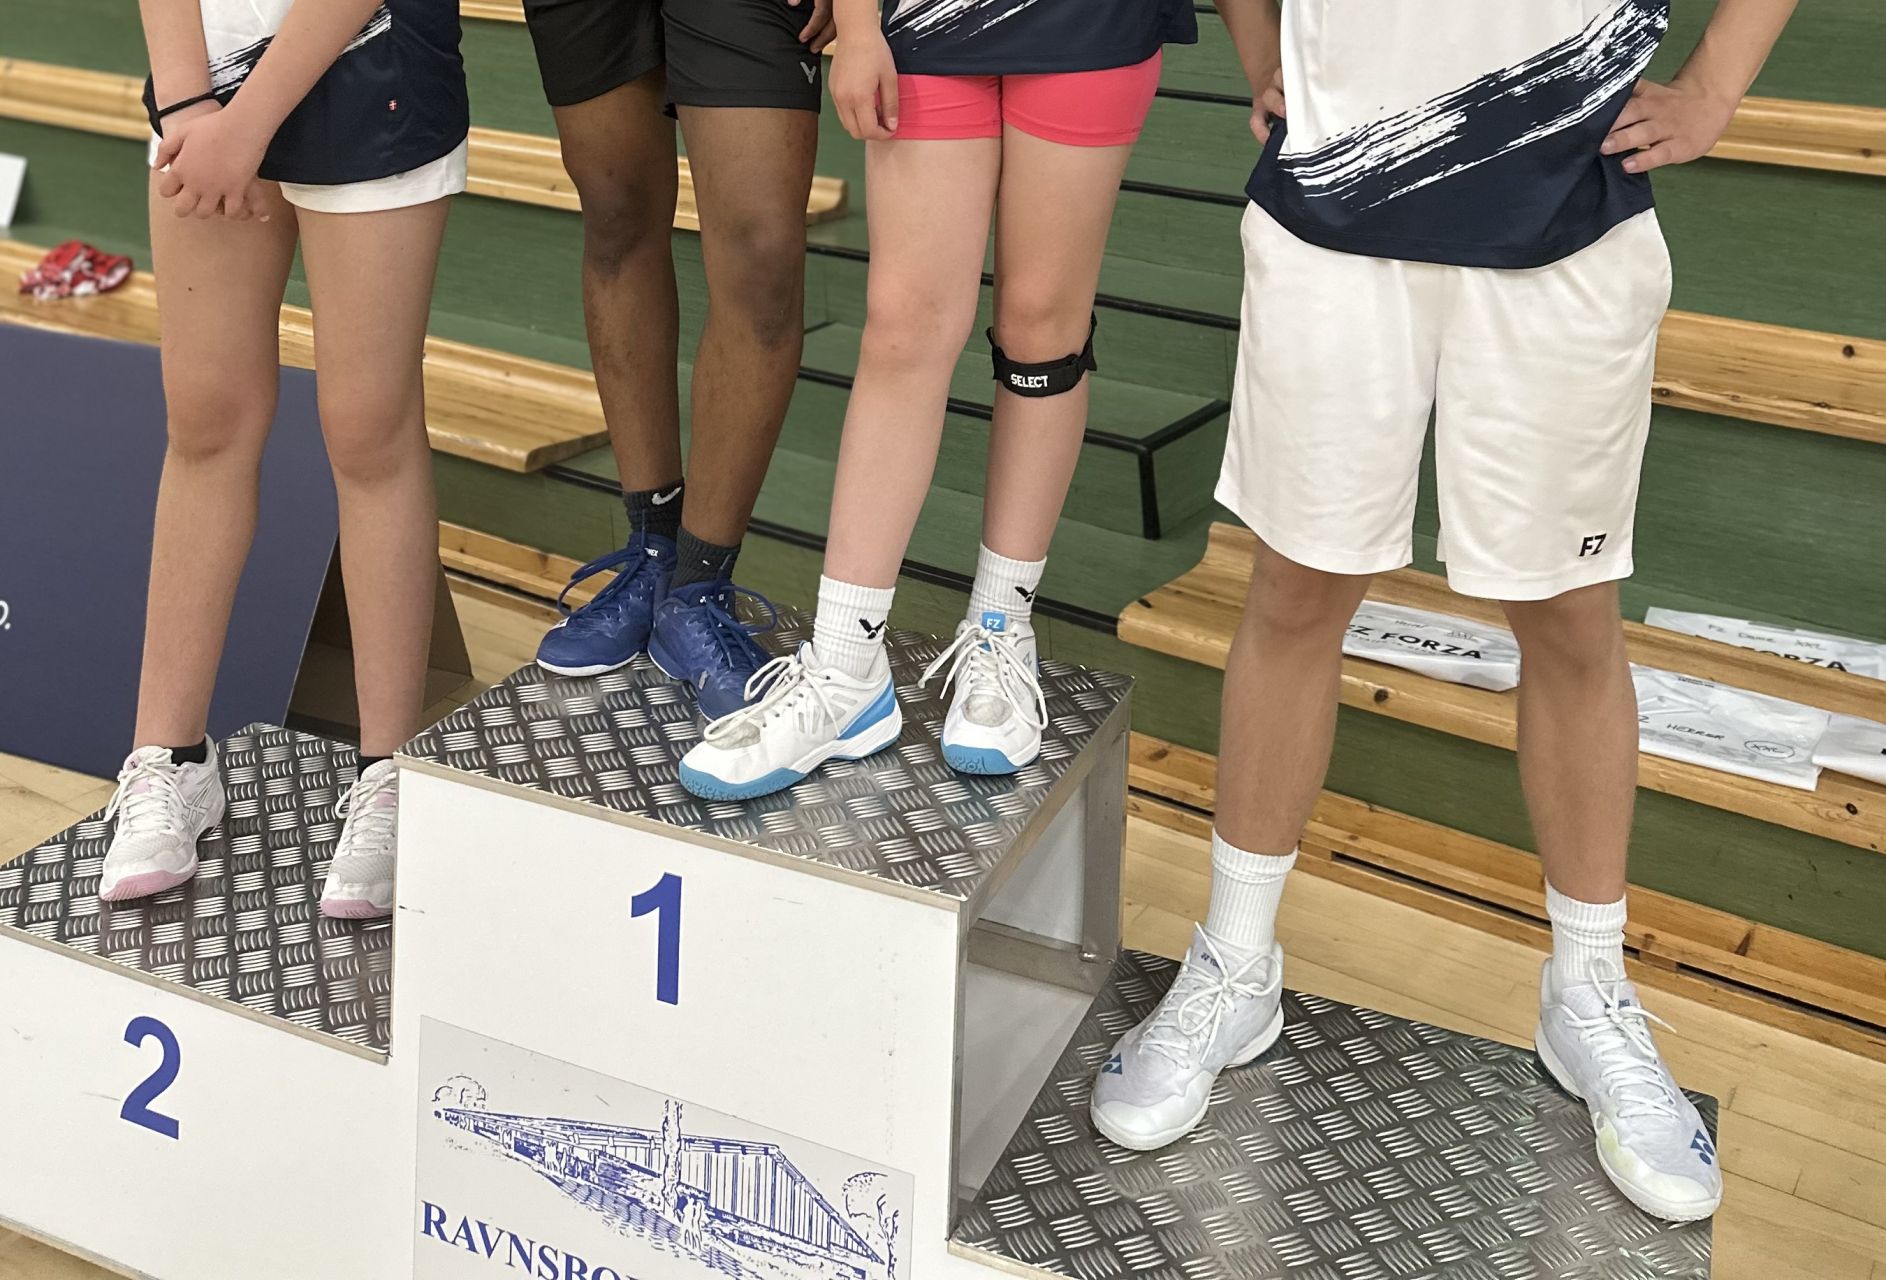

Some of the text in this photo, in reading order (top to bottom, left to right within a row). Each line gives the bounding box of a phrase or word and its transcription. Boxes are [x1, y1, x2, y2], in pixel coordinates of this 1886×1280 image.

[1010, 373, 1048, 388] SELECT
[1578, 533, 1607, 557] FZ
[986, 618, 1001, 629] FZ
[1381, 632, 1482, 659] FORZA
[631, 872, 682, 1005] 1
[120, 1016, 181, 1140] 2
[420, 1199, 640, 1280] RAVNSB
